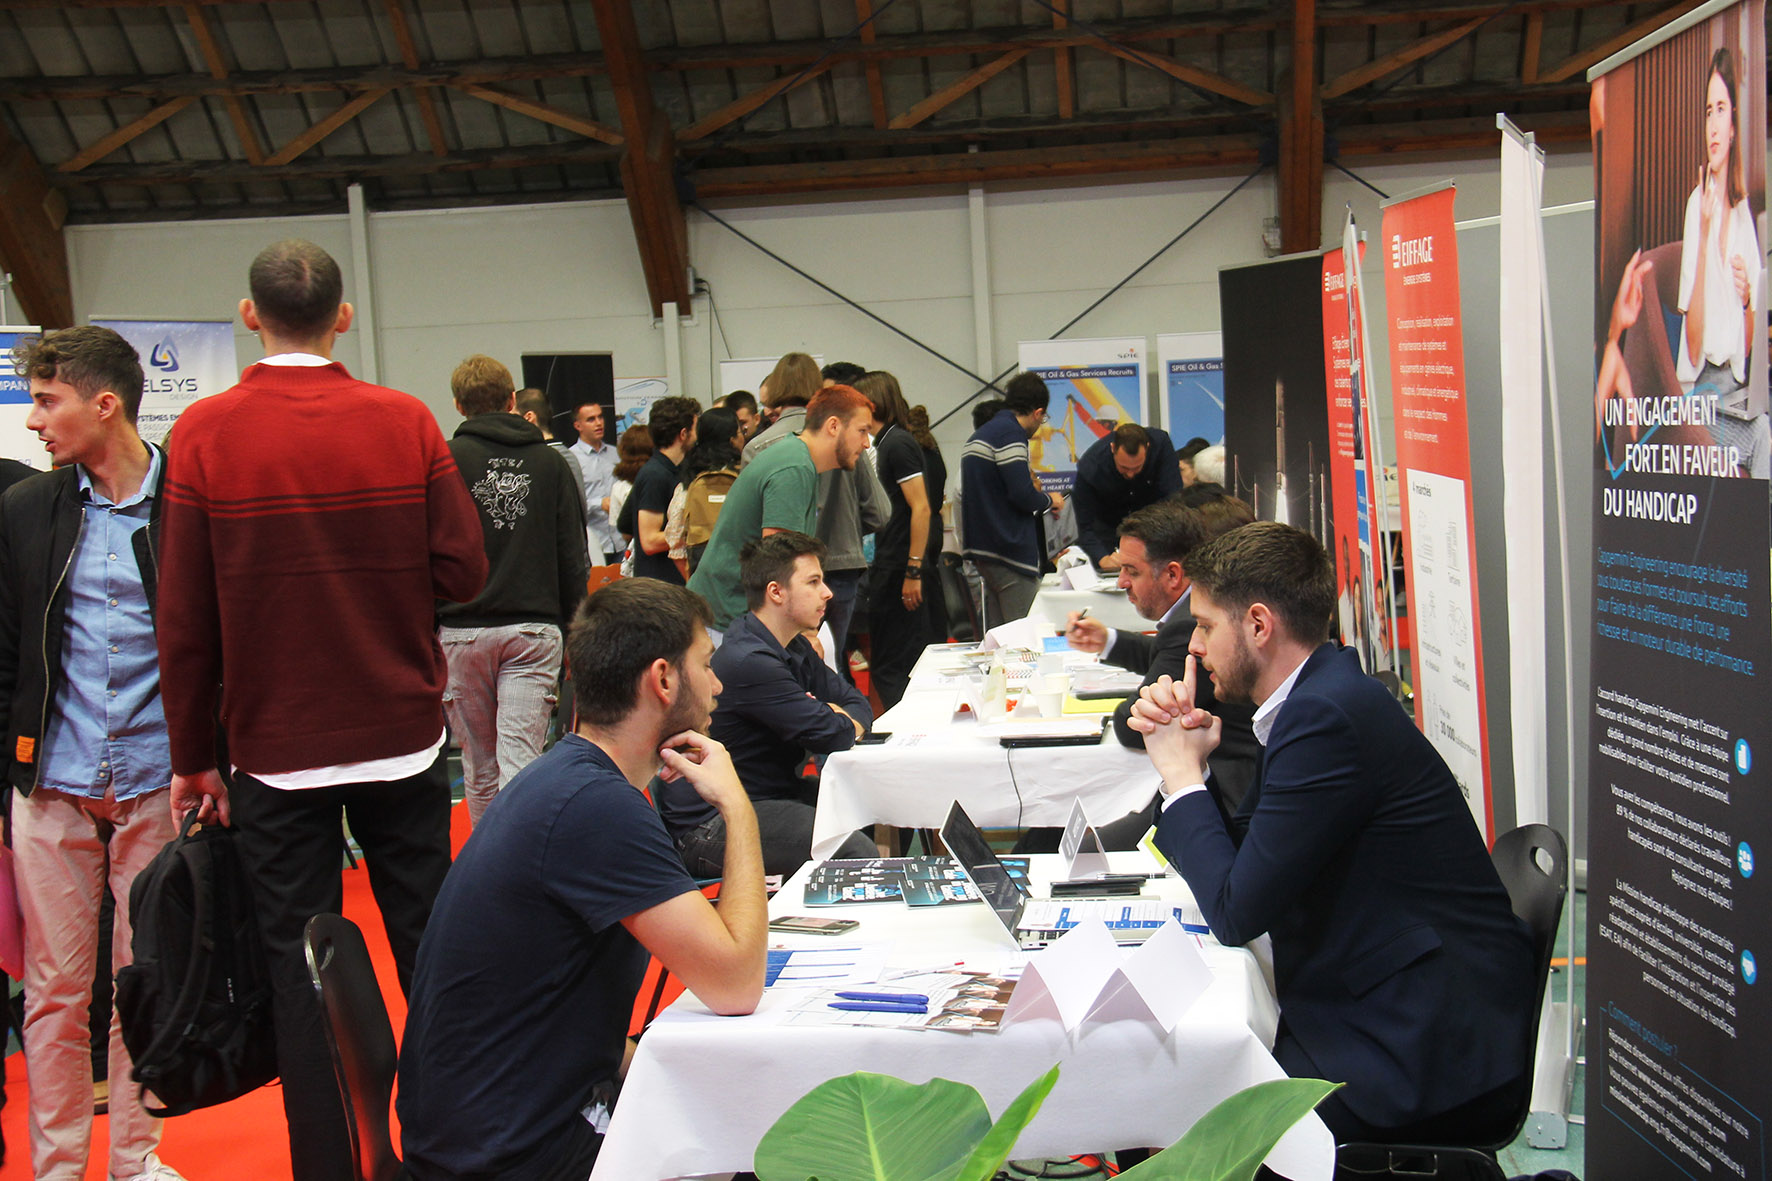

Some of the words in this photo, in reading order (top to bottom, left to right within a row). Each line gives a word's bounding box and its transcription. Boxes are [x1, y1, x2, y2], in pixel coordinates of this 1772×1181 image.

[1402, 236, 1433, 267] EIFFAGE
[1108, 368, 1134, 376] Recruits
[1172, 364, 1186, 372] SPIE
[1188, 363, 1198, 371] Oil
[1605, 398, 1622, 426] UN
[1626, 395, 1719, 426] ENGAGEMENT
[1625, 443, 1659, 473] FORT
[1662, 444, 1680, 474] EN
[1683, 445, 1740, 478] FAVEUR
[1603, 487, 1622, 517] DU
[1625, 489, 1697, 524] HANDICAP
